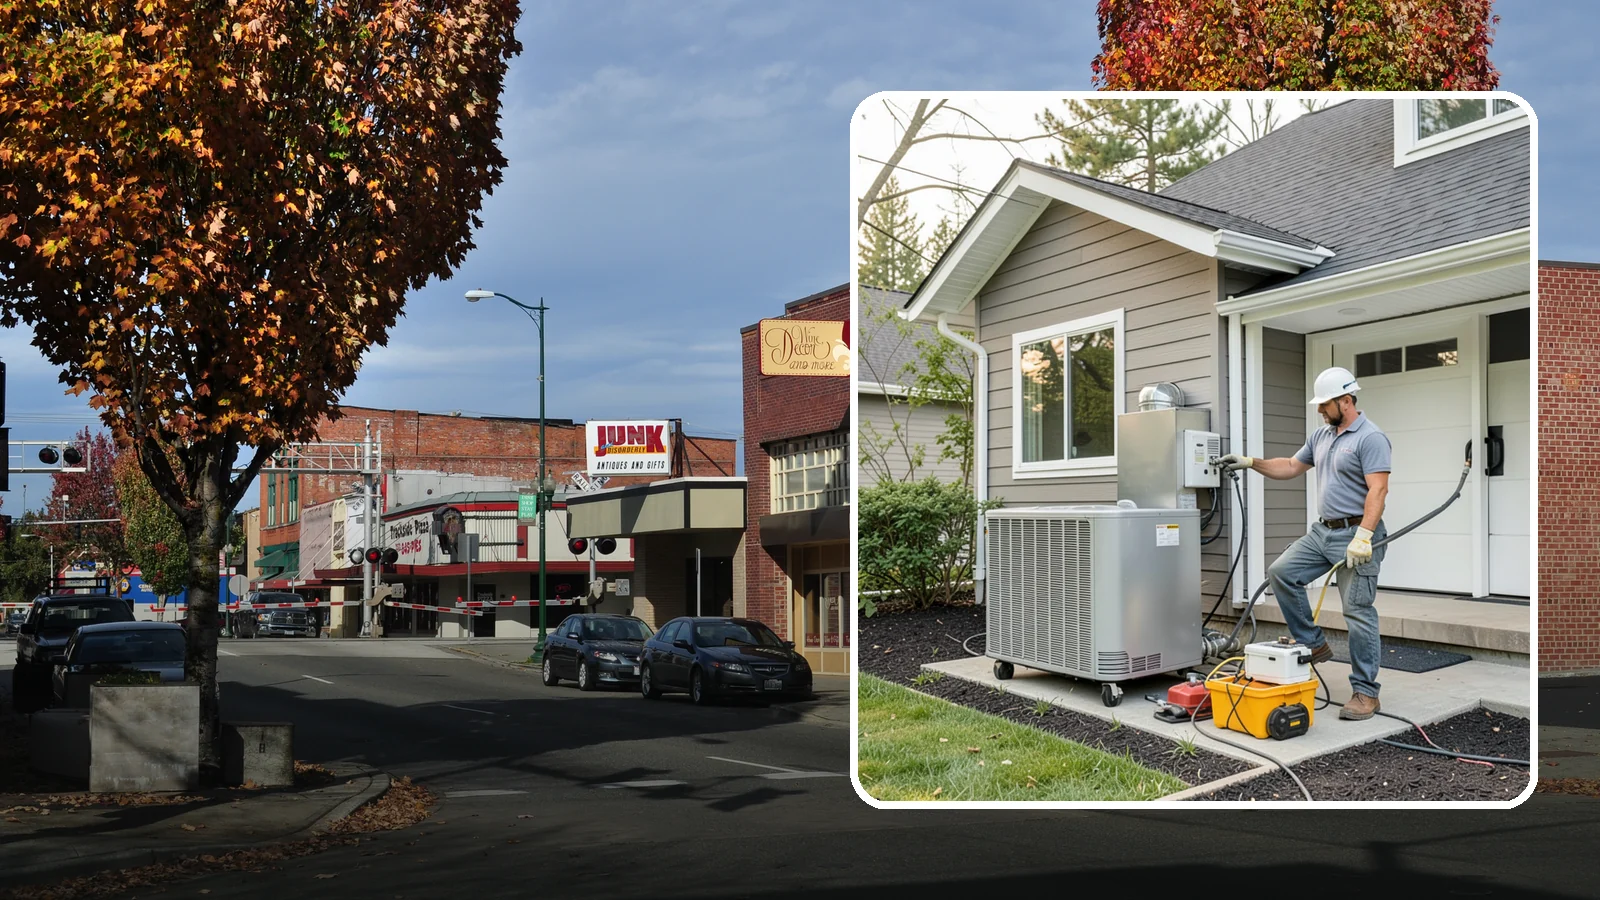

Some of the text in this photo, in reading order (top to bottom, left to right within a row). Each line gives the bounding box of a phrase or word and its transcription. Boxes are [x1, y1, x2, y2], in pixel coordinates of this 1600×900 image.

[595, 425, 665, 457] JUNK
[607, 446, 646, 454] DISORDERLY
[597, 460, 665, 470] ANTIQUES AND GIFTS
[414, 520, 429, 535] Pizza
